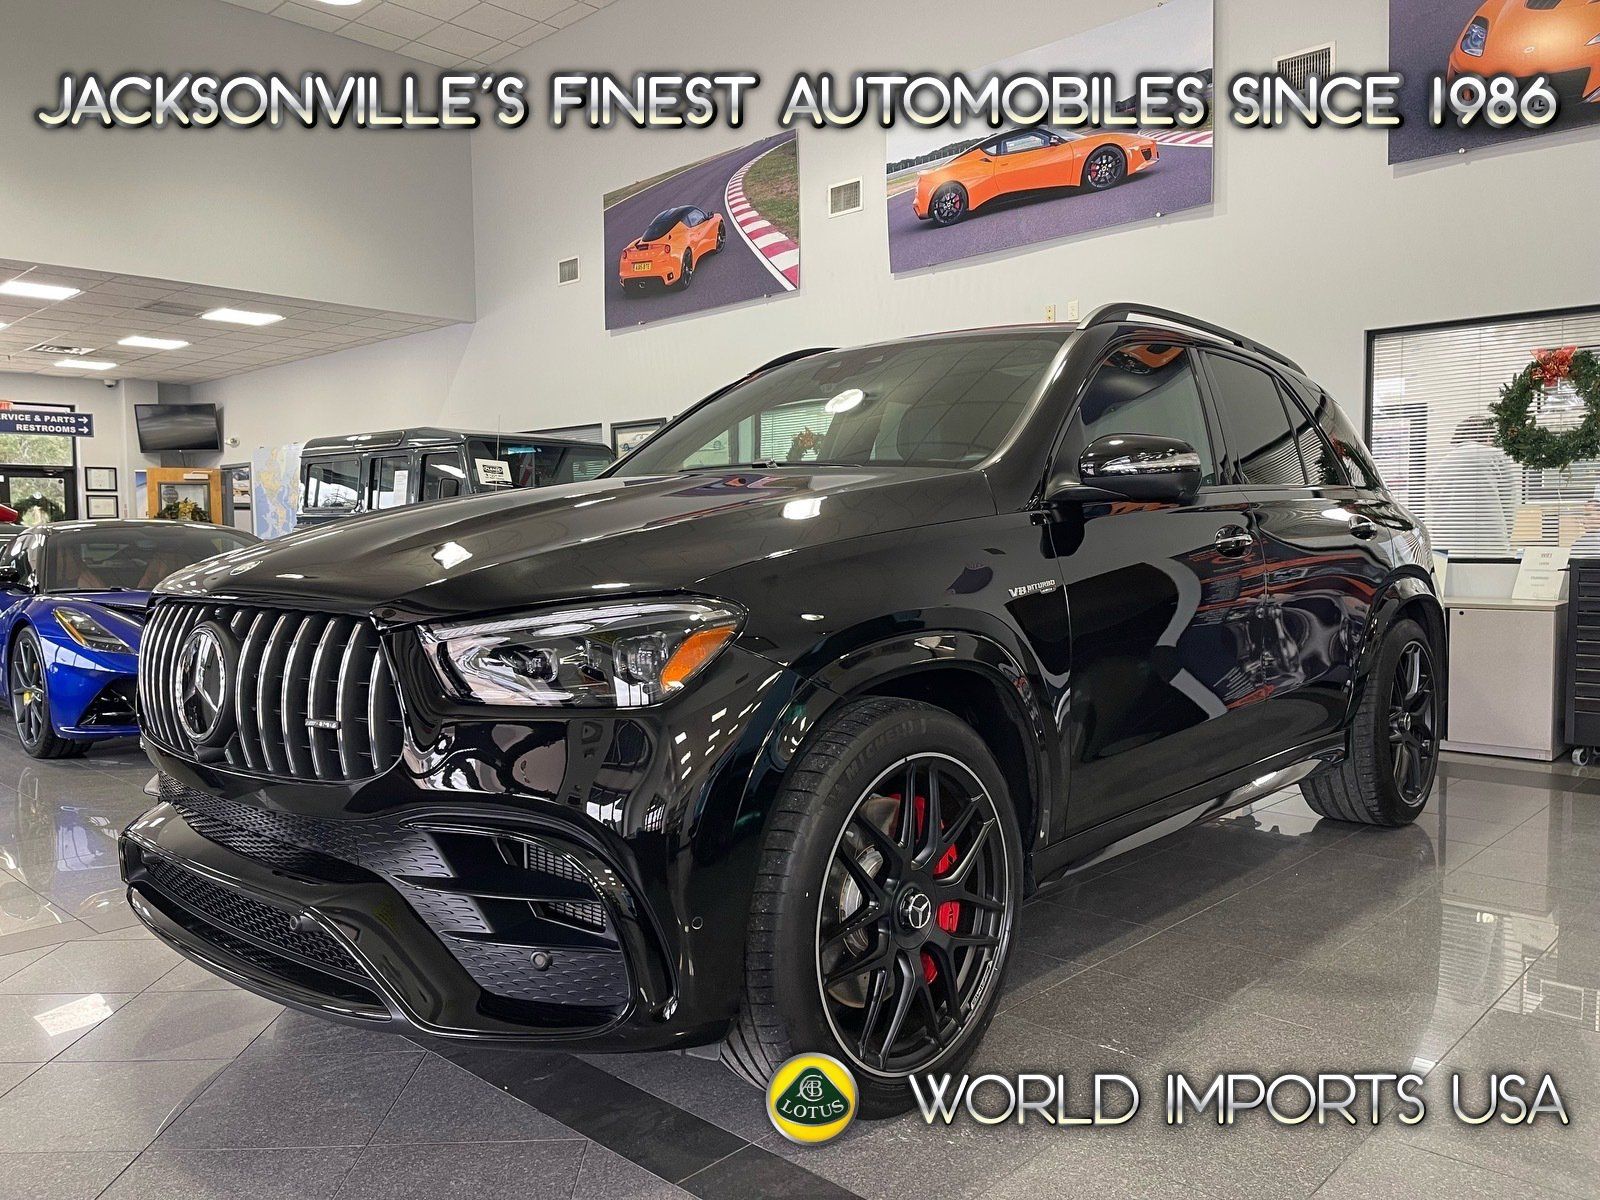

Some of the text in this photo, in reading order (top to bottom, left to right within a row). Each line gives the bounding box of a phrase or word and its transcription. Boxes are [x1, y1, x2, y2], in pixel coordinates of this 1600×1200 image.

[0, 413, 31, 422] RVICE
[44, 415, 76, 424] PARTS
[16, 423, 76, 434] RESTROOMS
